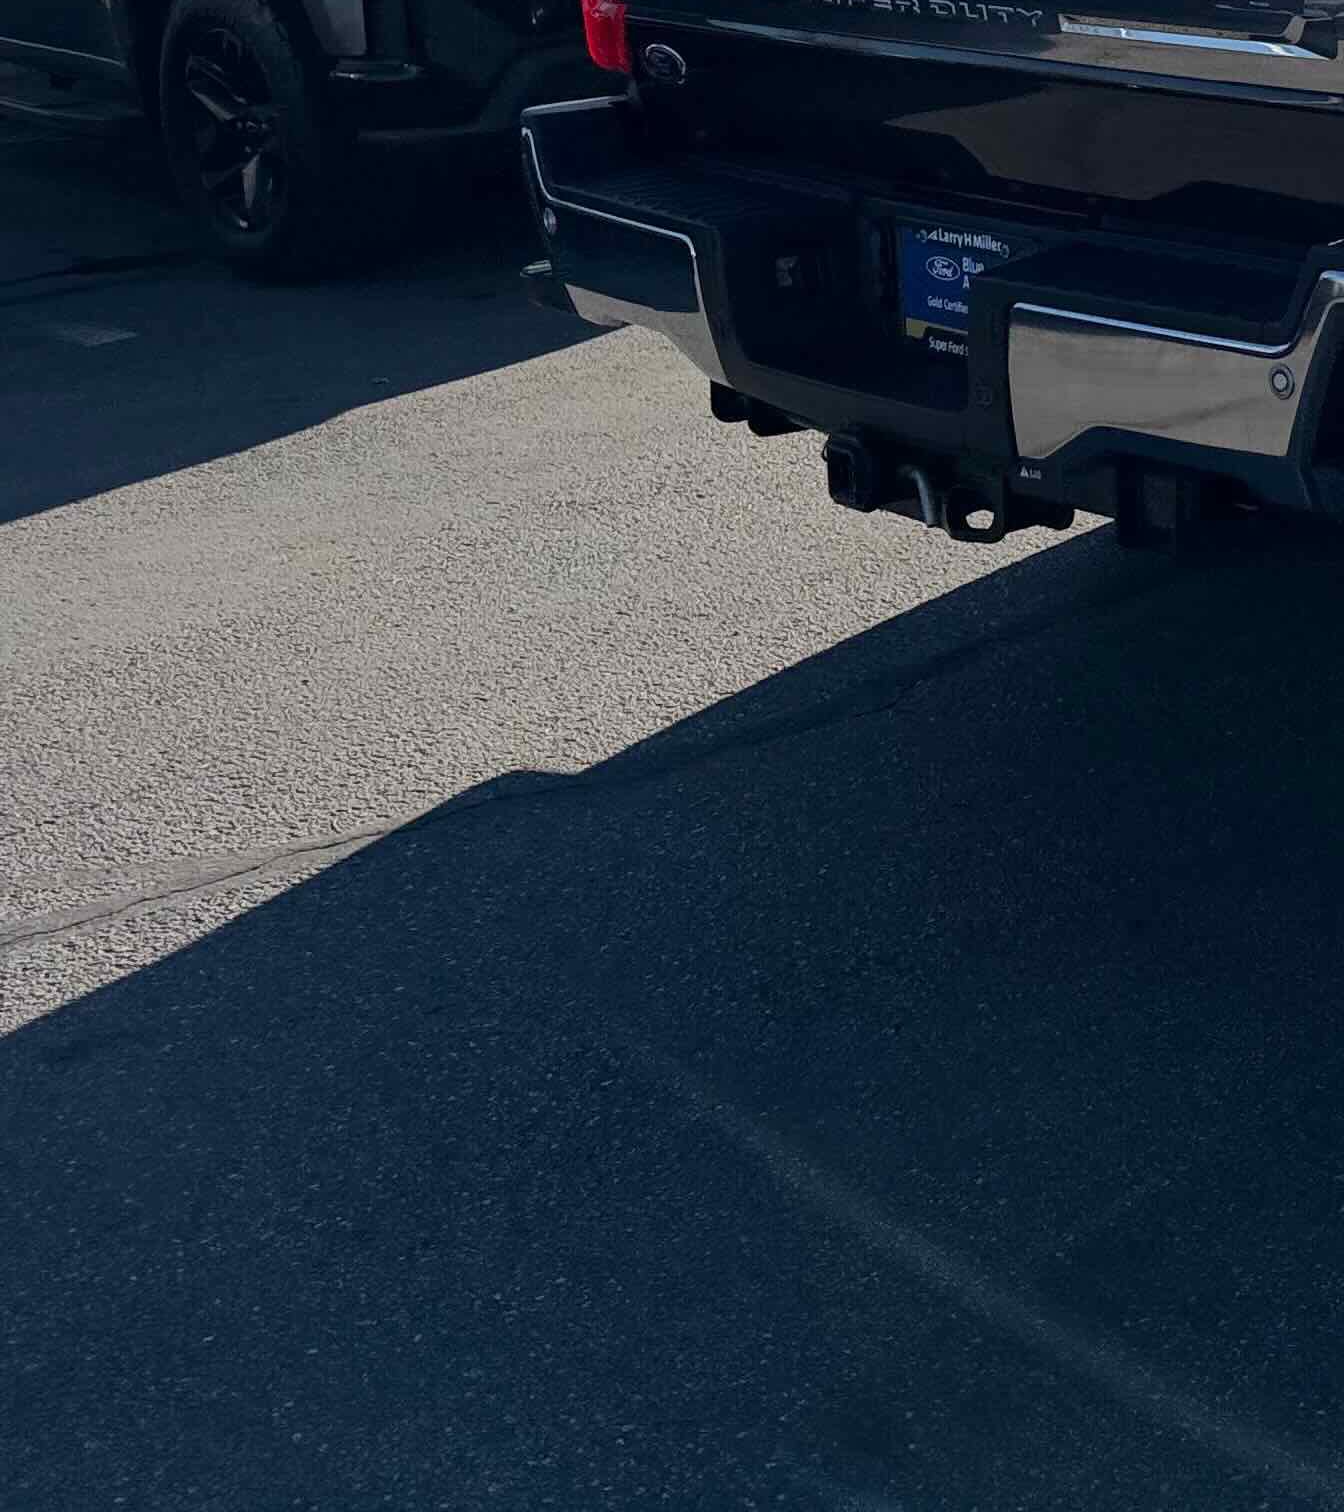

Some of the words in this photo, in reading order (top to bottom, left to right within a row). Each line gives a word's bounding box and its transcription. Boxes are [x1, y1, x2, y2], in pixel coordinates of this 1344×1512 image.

[938, 228, 963, 248] Larry
[964, 232, 972, 247] H
[973, 234, 1002, 252] Miller
